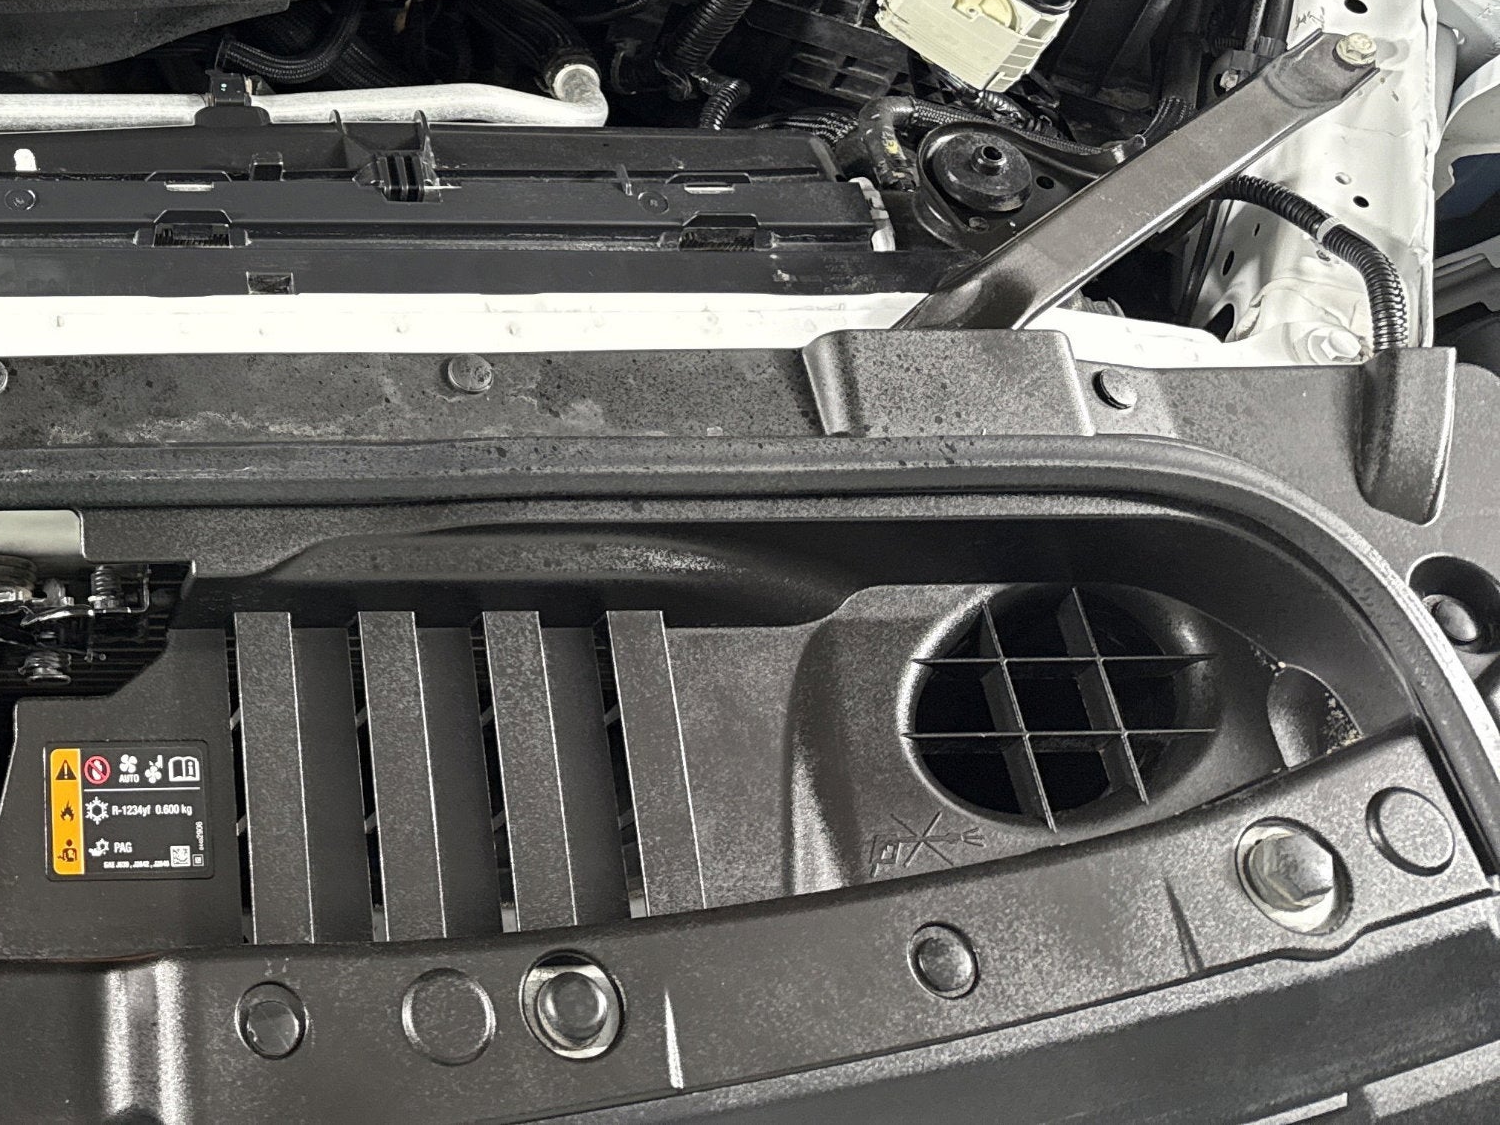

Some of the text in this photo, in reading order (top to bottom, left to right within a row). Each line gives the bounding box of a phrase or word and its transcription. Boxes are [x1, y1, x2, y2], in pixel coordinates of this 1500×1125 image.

[119, 774, 139, 783] AUTO
[111, 803, 193, 817] R-1234yf 0.600 kg
[113, 842, 132, 853] PAG
